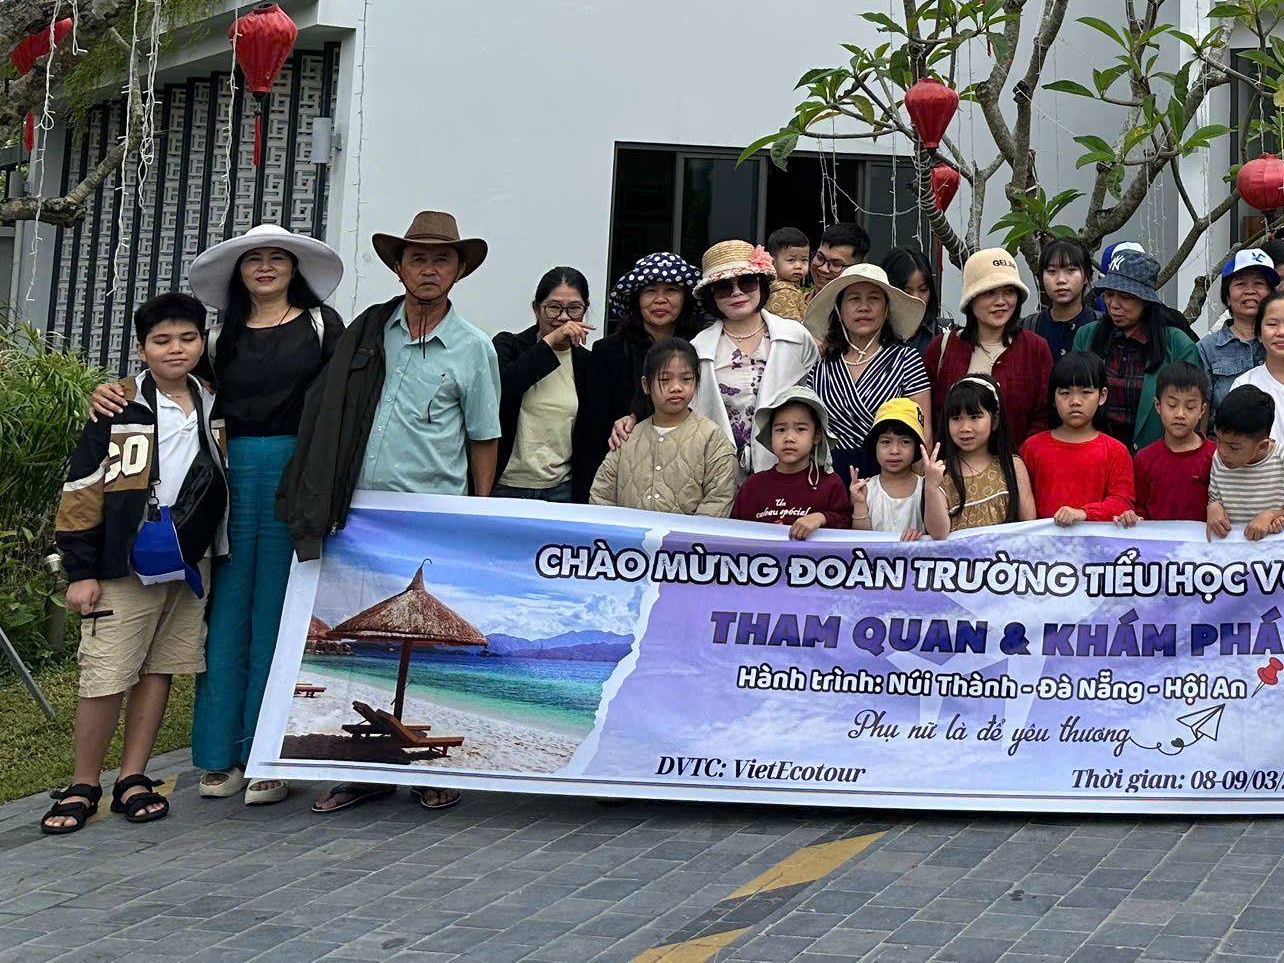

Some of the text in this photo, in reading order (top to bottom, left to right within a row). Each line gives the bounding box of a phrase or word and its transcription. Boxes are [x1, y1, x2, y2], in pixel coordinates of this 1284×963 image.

[536, 539, 649, 581] CHÀO
[650, 544, 781, 586] MỪNG
[787, 548, 907, 589] ĐOÀN
[911, 550, 1079, 596] TRƯỜNG
[1083, 546, 1160, 597] TIỂU
[1167, 560, 1248, 604] HỌC
[710, 605, 1284, 657] THAM QUAN & KHÁM PHÁ
[737, 663, 807, 692] Hành
[809, 667, 884, 694] trình:
[887, 669, 933, 696] Núi
[935, 671, 1017, 699] Thành
[1037, 674, 1072, 700] Đà
[1077, 669, 1144, 704] Nẵng
[1162, 673, 1209, 705] Hội
[1209, 677, 1248, 699] An
[847, 709, 1131, 757] Phụ nữ là để yêu thương
[655, 755, 867, 782] DVTC: VietEcotour
[1071, 769, 1125, 789] Thời
[1128, 773, 1186, 793] gian:
